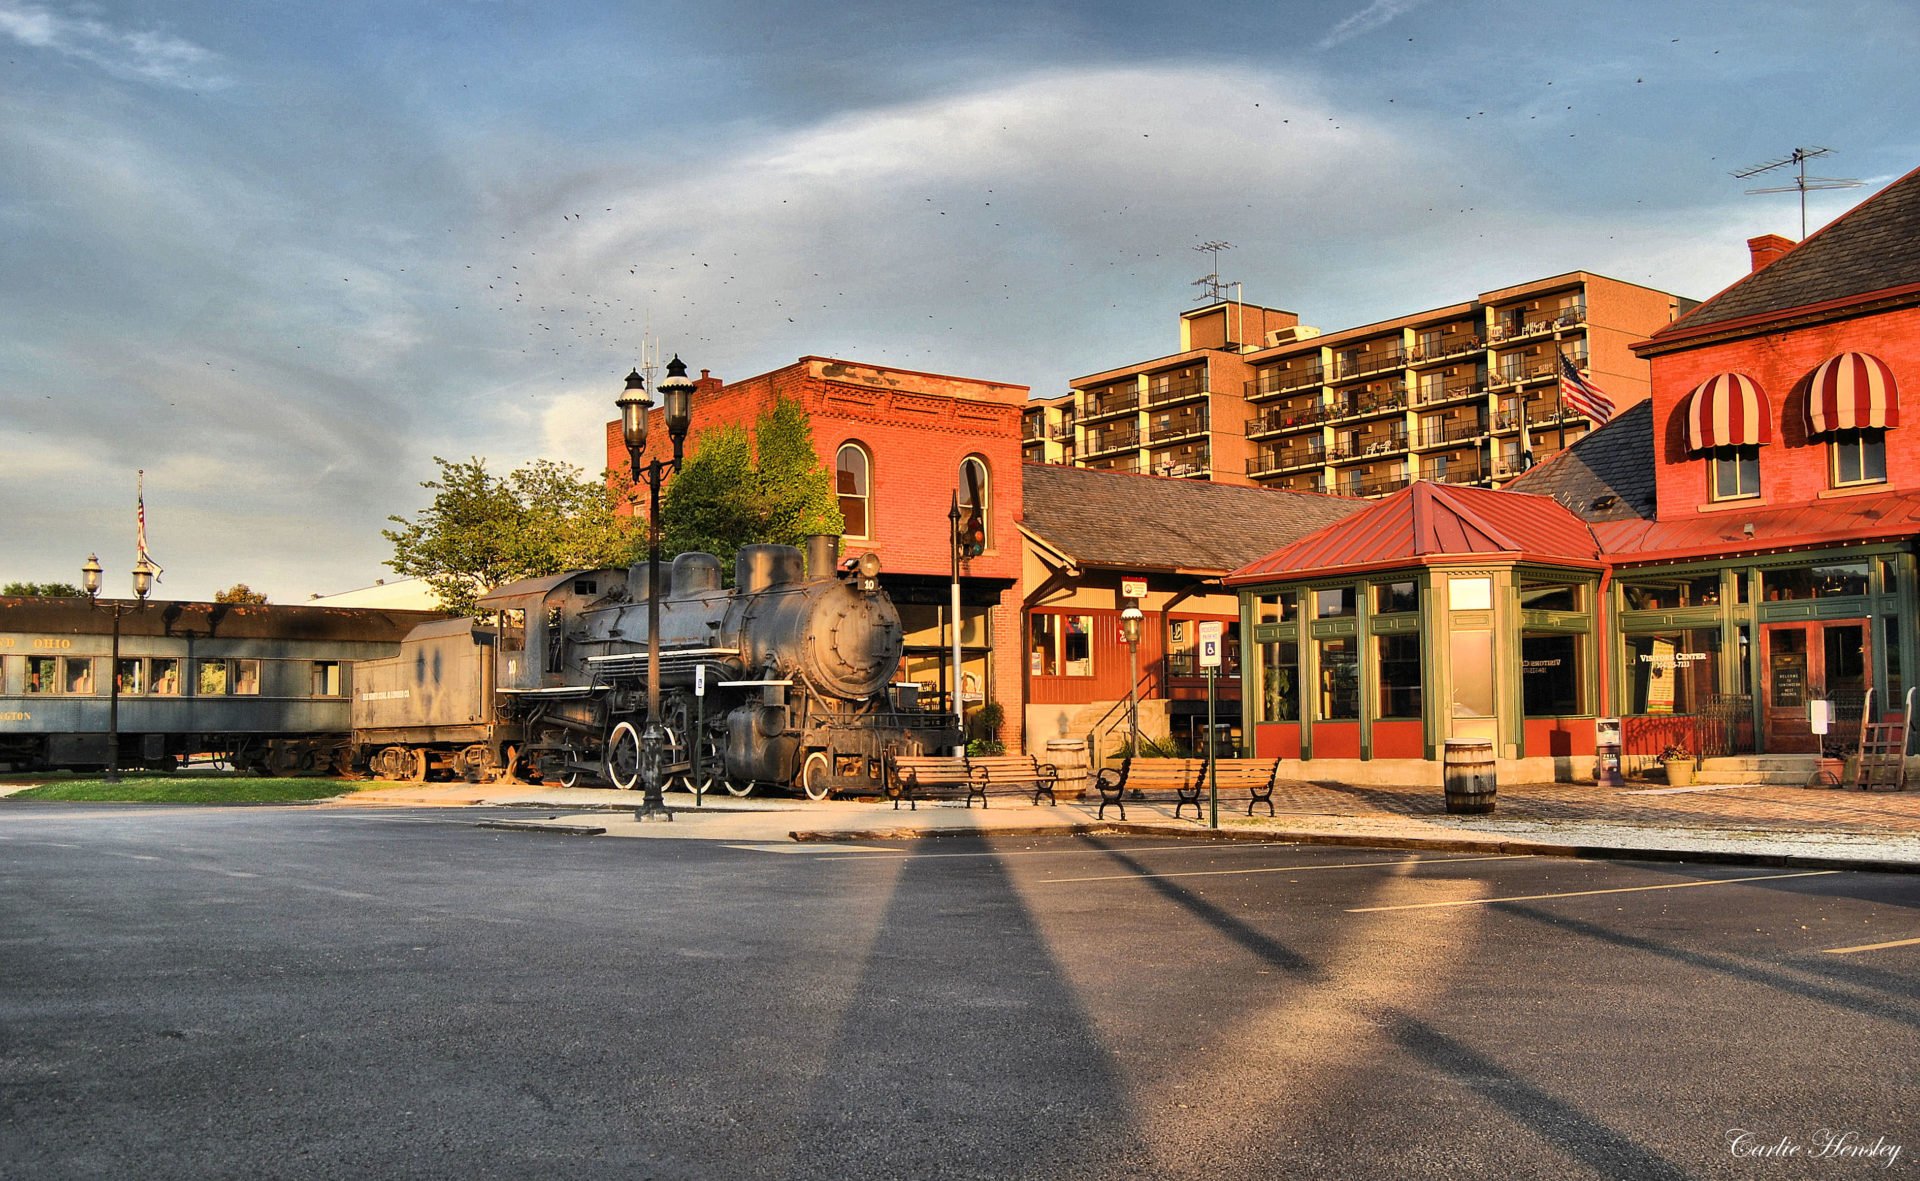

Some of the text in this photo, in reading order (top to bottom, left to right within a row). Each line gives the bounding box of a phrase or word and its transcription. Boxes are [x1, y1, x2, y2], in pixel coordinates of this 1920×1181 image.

[864, 580, 875, 590] 10
[33, 638, 71, 649] OHIO
[1676, 652, 1707, 660] CENTER
[508, 659, 517, 674] 10
